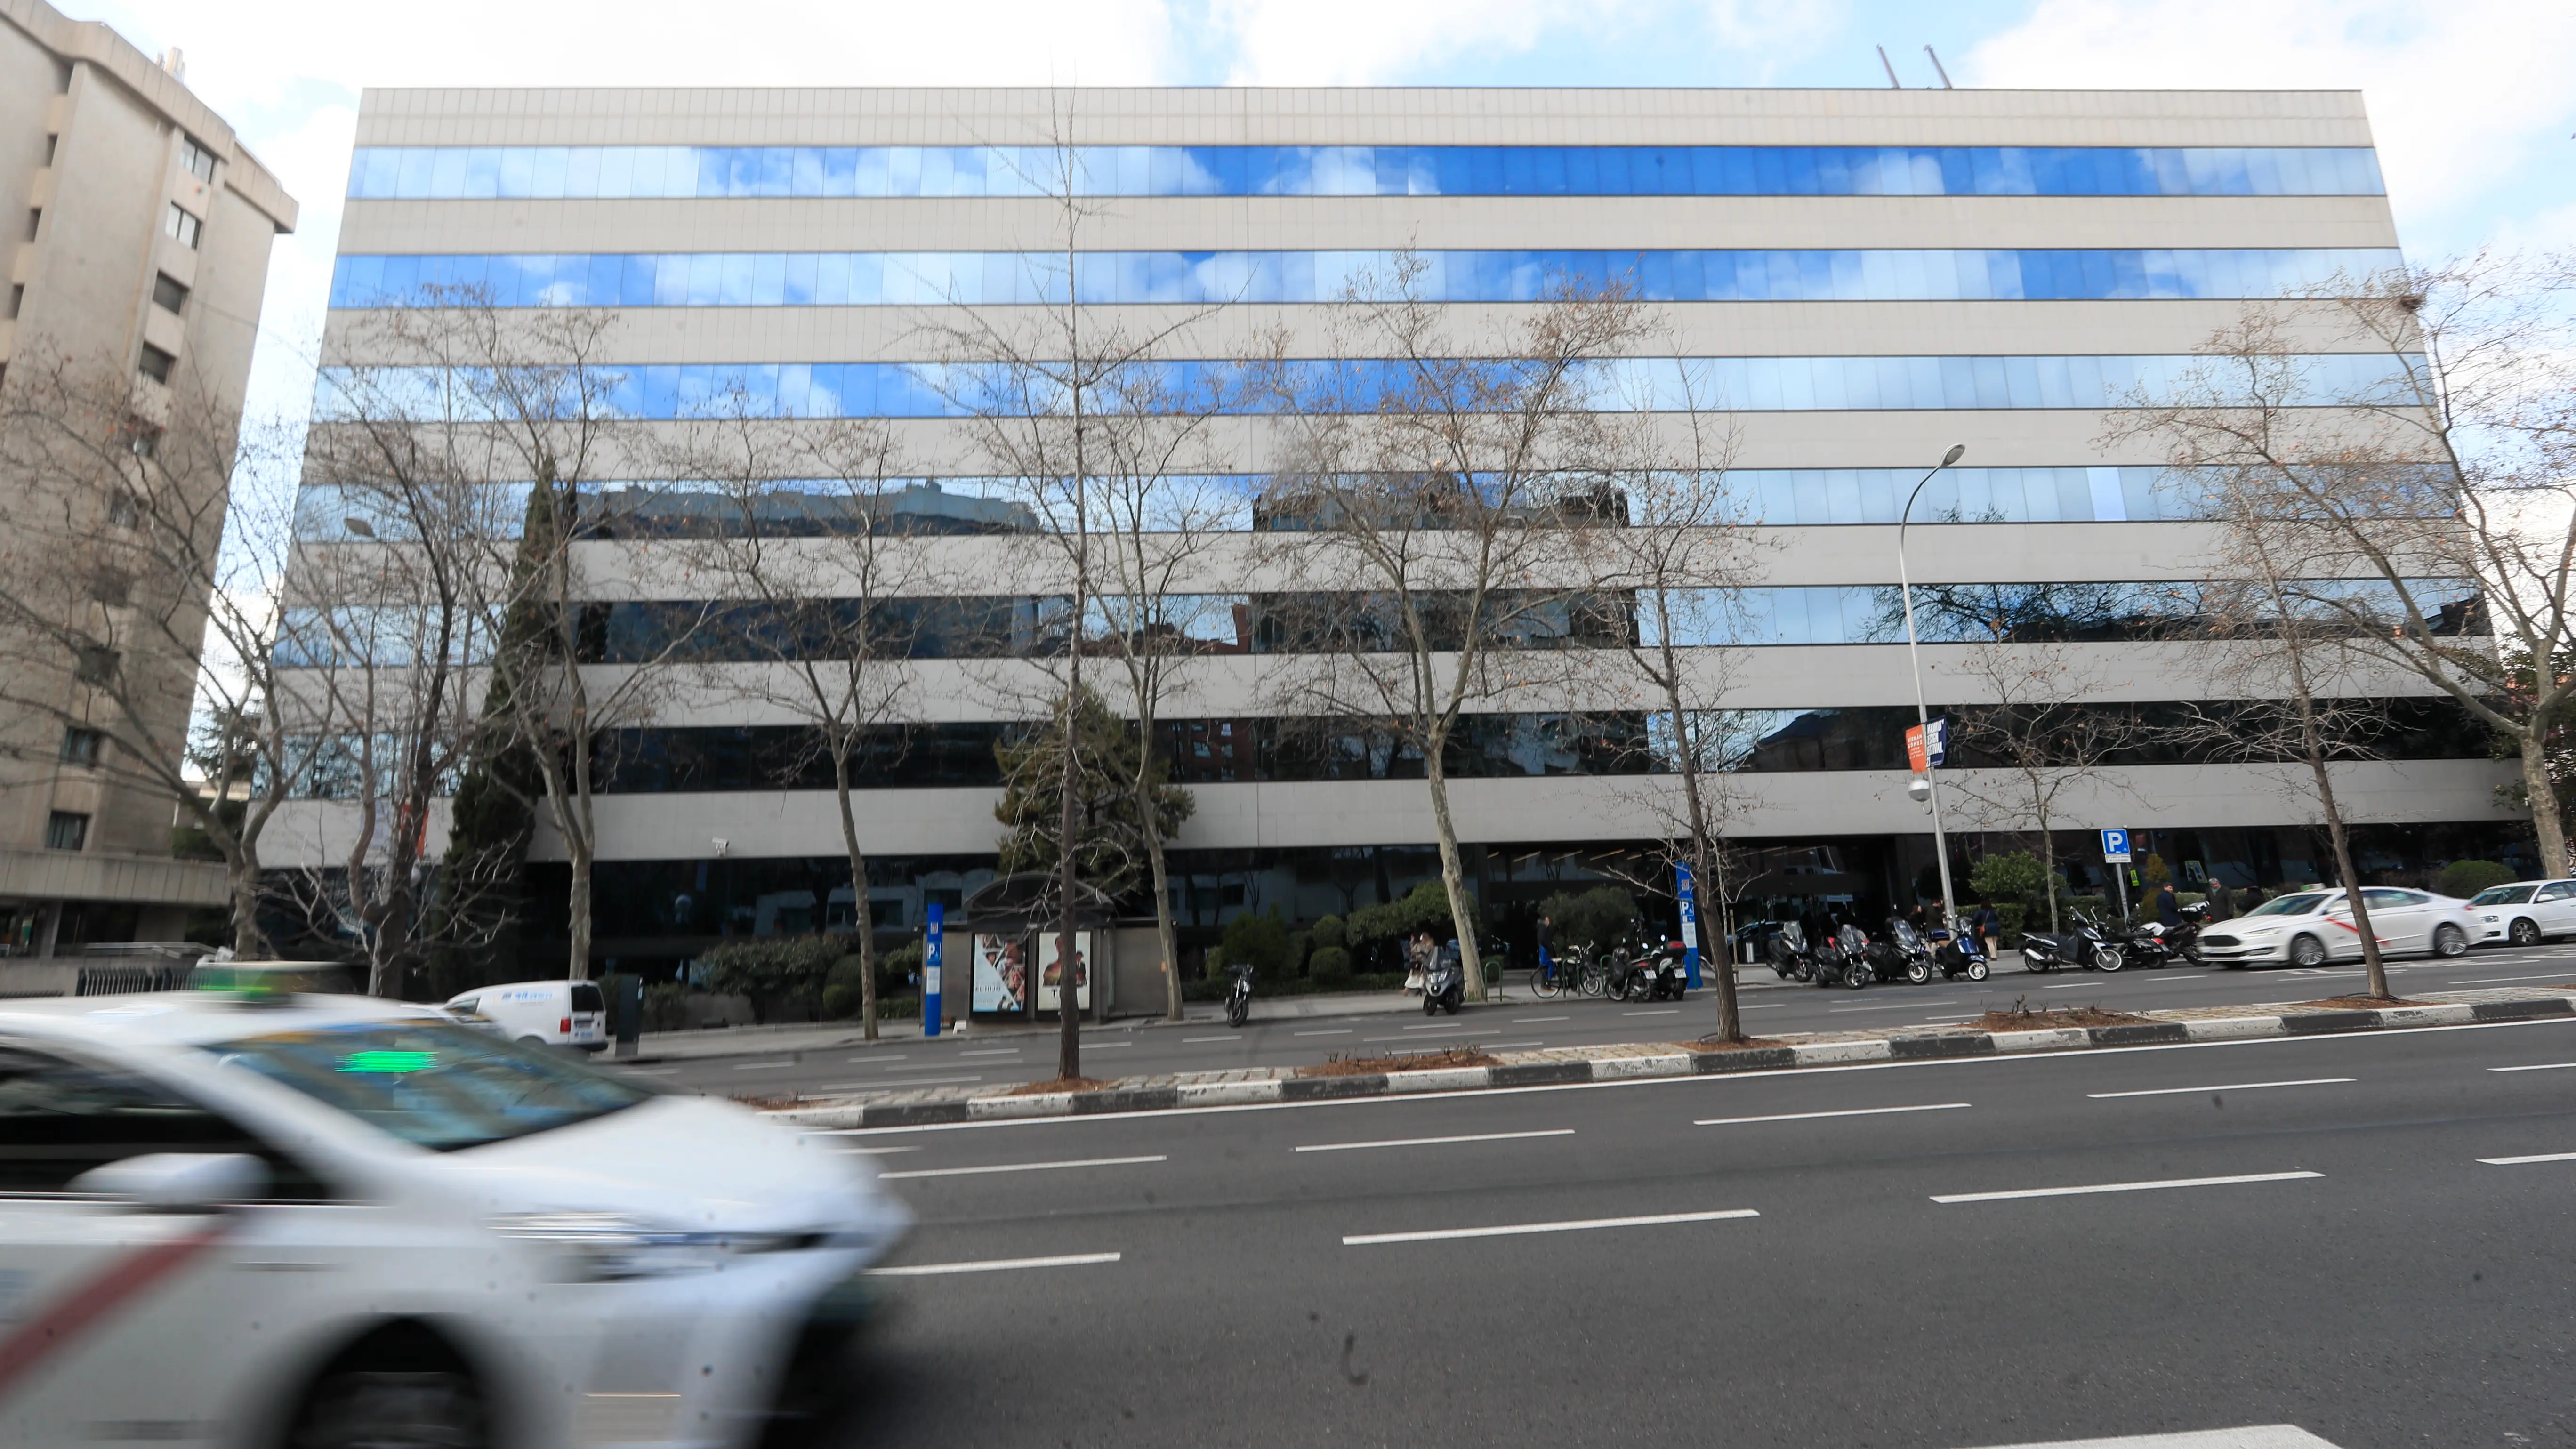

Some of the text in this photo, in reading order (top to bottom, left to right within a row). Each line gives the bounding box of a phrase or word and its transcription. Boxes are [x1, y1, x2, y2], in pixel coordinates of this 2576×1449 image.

[2107, 832, 2123, 852] P
[1682, 901, 1689, 914] P
[928, 942, 935, 959] P
